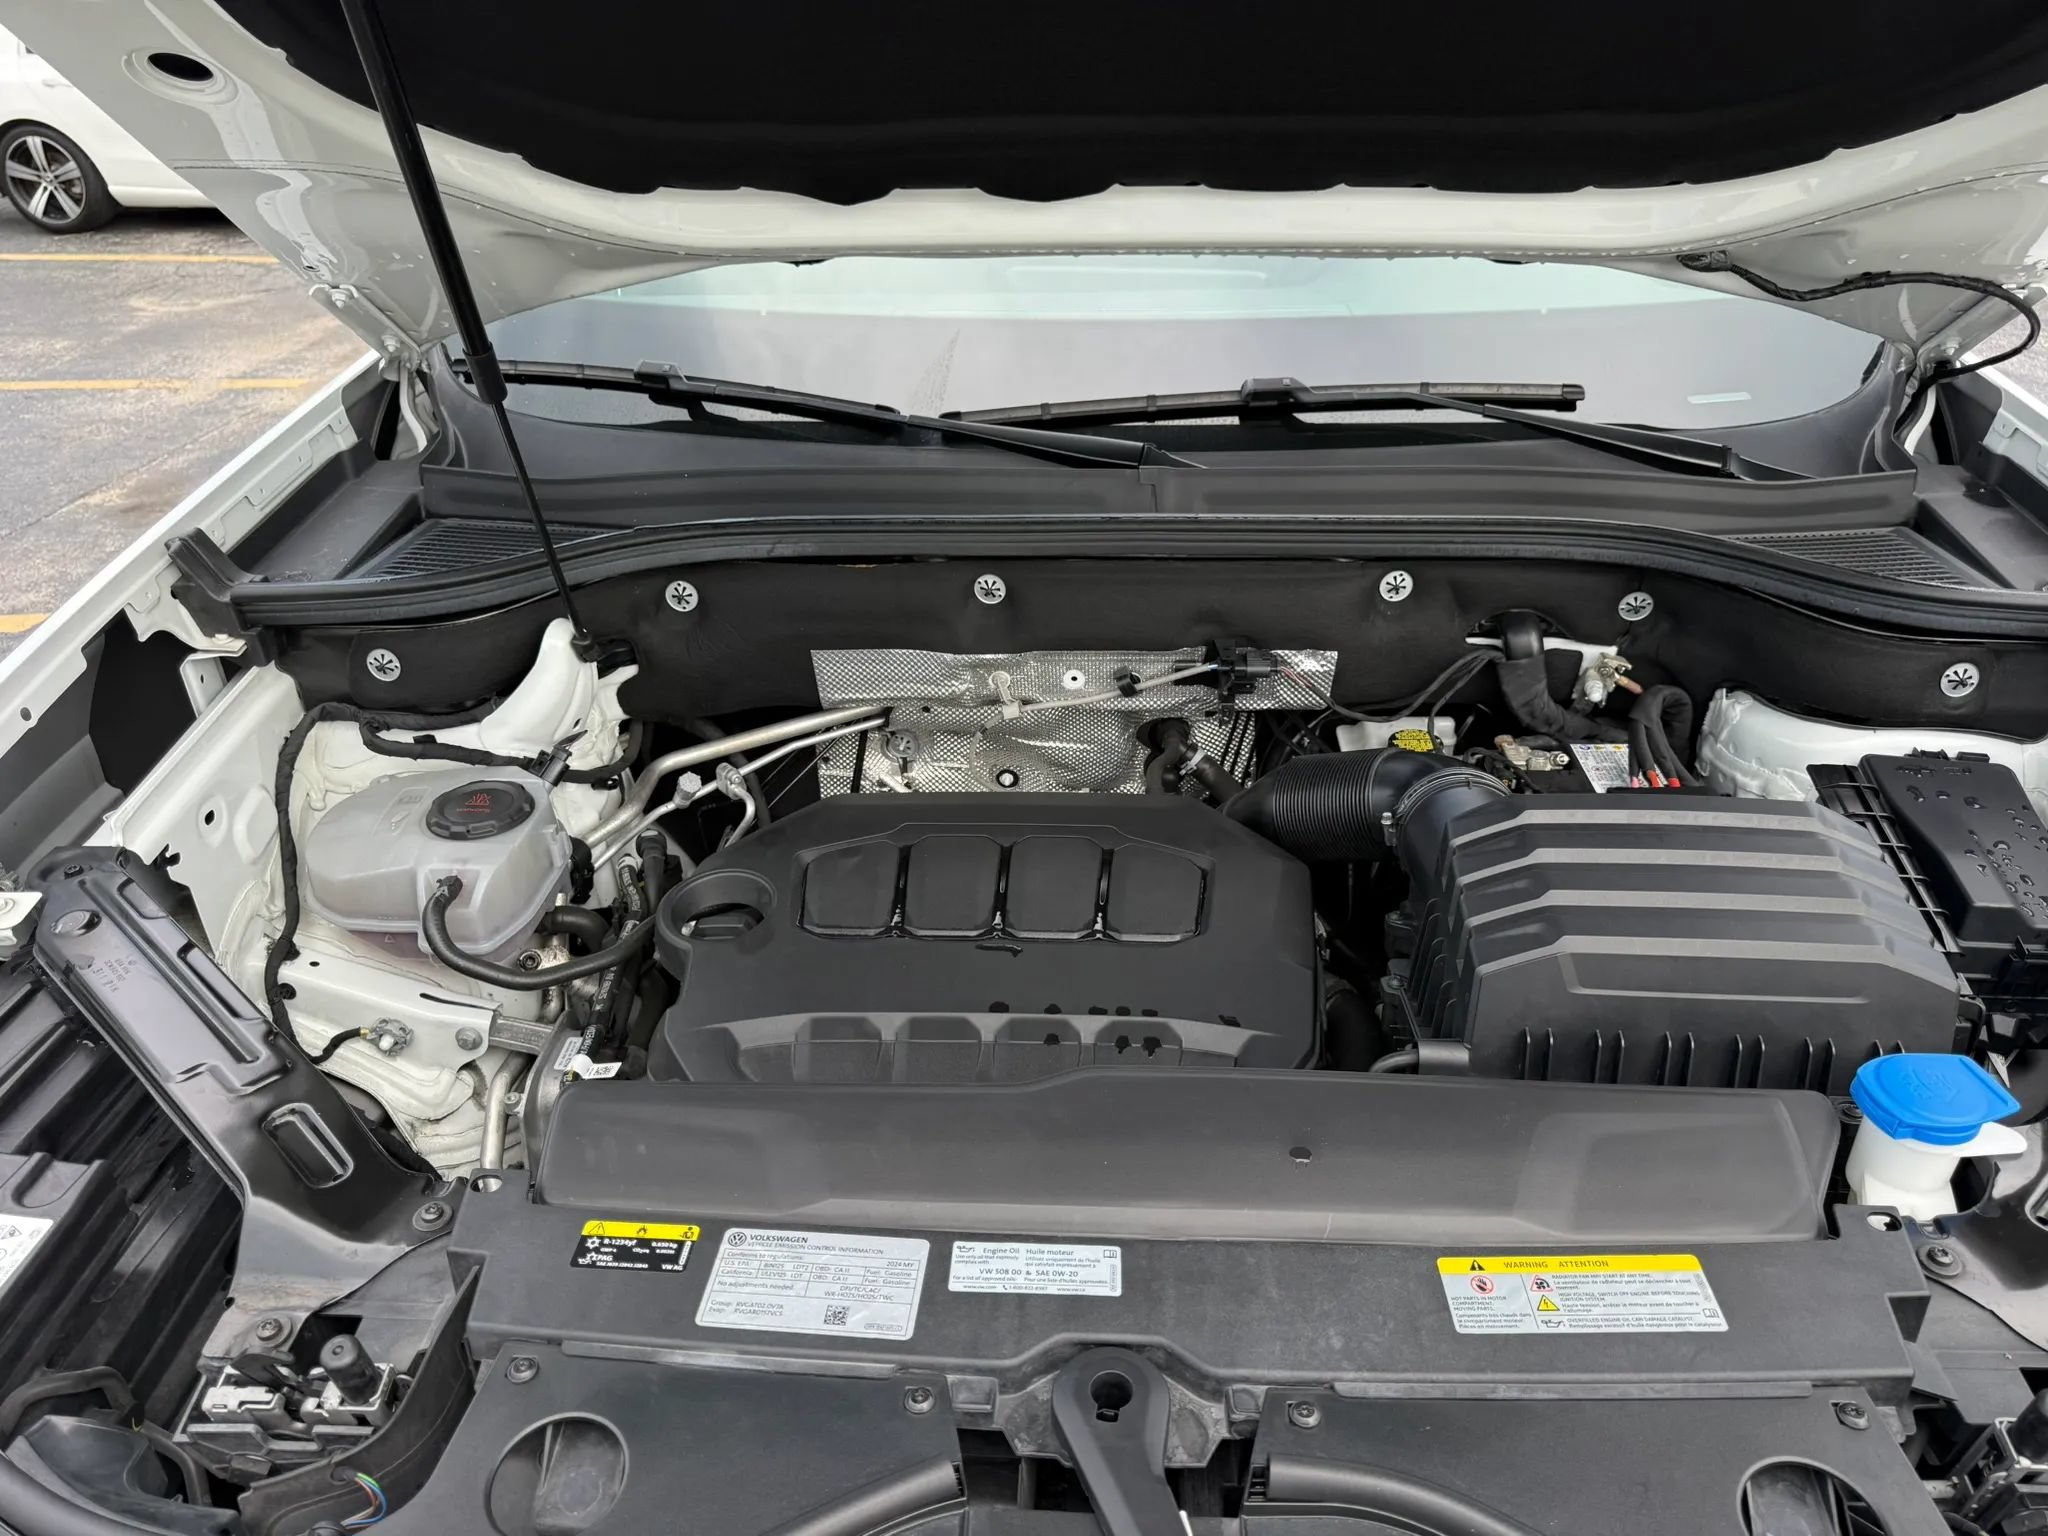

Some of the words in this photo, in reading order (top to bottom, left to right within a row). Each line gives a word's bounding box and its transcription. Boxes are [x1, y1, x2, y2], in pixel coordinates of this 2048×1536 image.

[750, 1234, 809, 1243] VOLKSWAGEN
[603, 1239, 637, 1247] R-1234yf
[838, 1247, 884, 1255] INFORMATION
[1559, 1260, 1609, 1268] ATTENTION
[1052, 1270, 1079, 1278] 0W-20
[728, 1281, 769, 1290] adjustments
